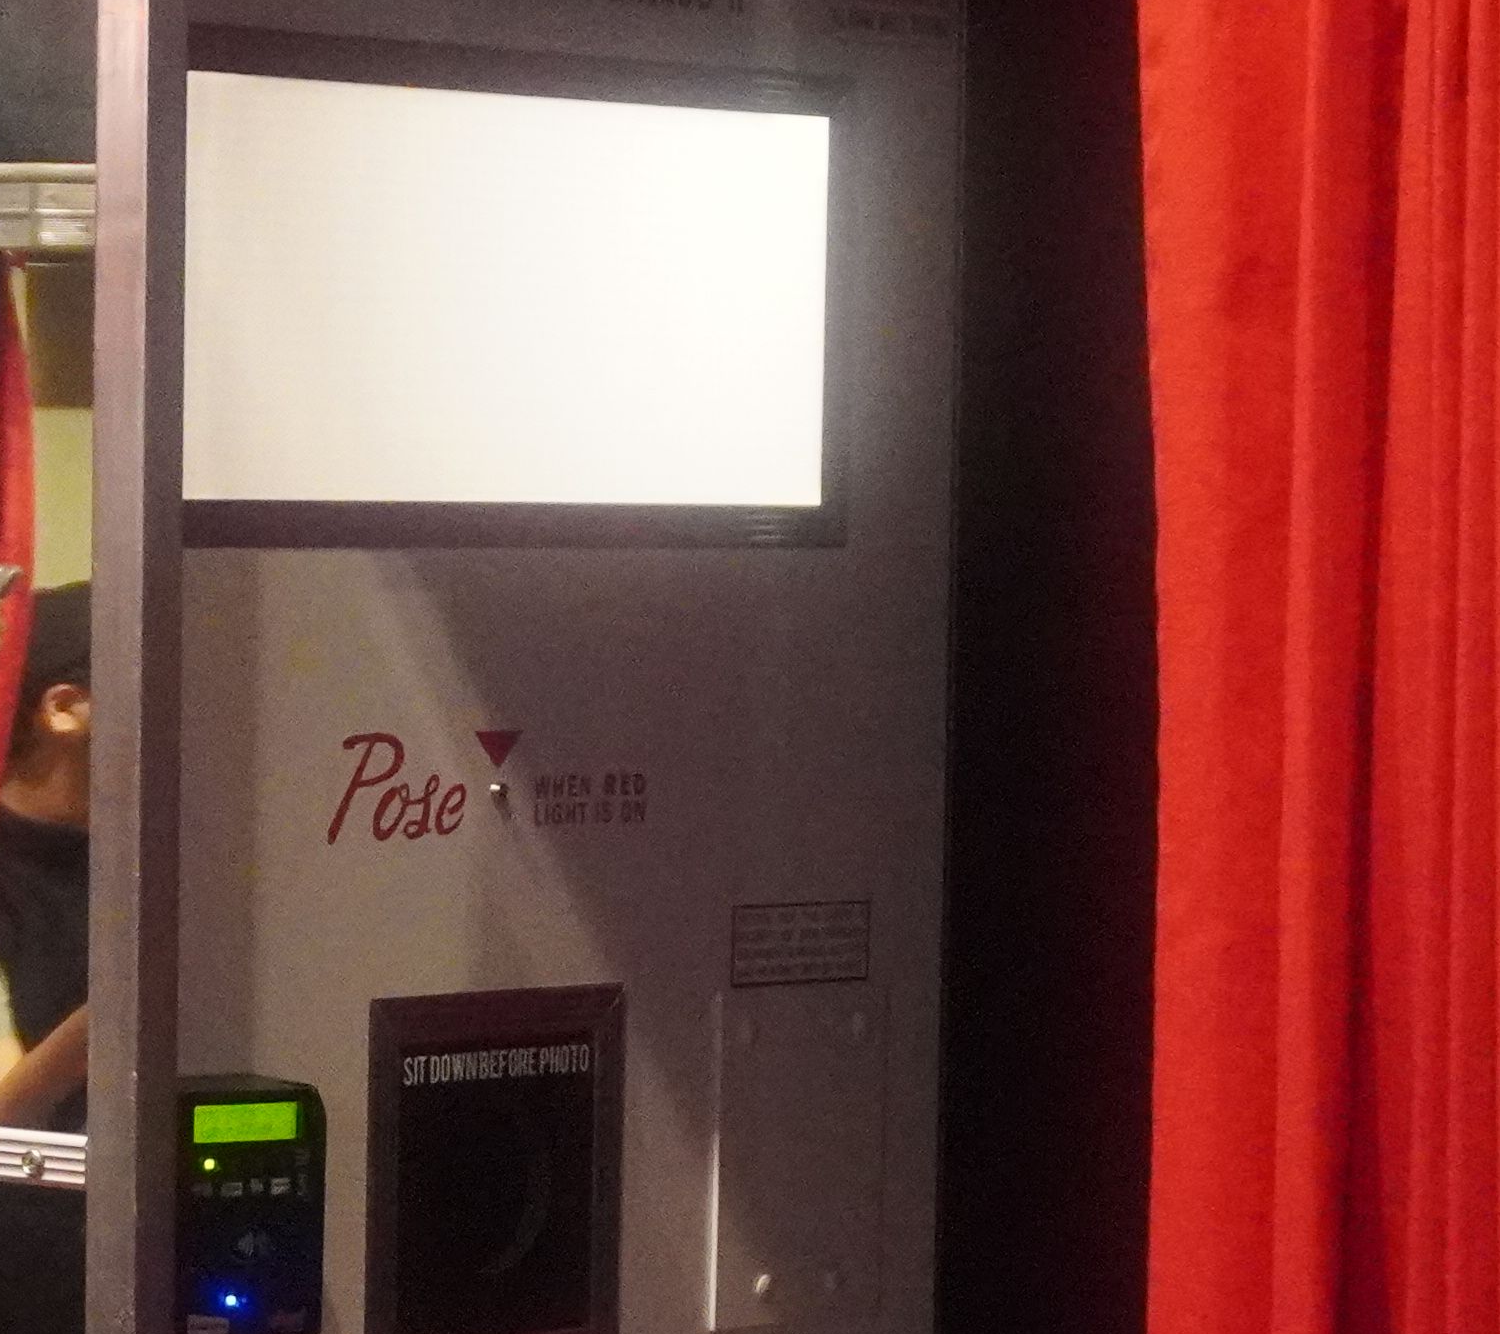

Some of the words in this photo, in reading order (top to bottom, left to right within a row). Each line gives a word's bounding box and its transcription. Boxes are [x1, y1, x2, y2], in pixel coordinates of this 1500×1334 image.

[327, 731, 468, 846] Pose
[534, 774, 592, 798] WHEN
[603, 772, 648, 796] RED
[533, 802, 588, 826] LIGHT
[595, 801, 613, 824] IS
[621, 799, 648, 824] ON
[403, 1056, 428, 1086] SIT
[539, 1044, 590, 1075] PHOTO
